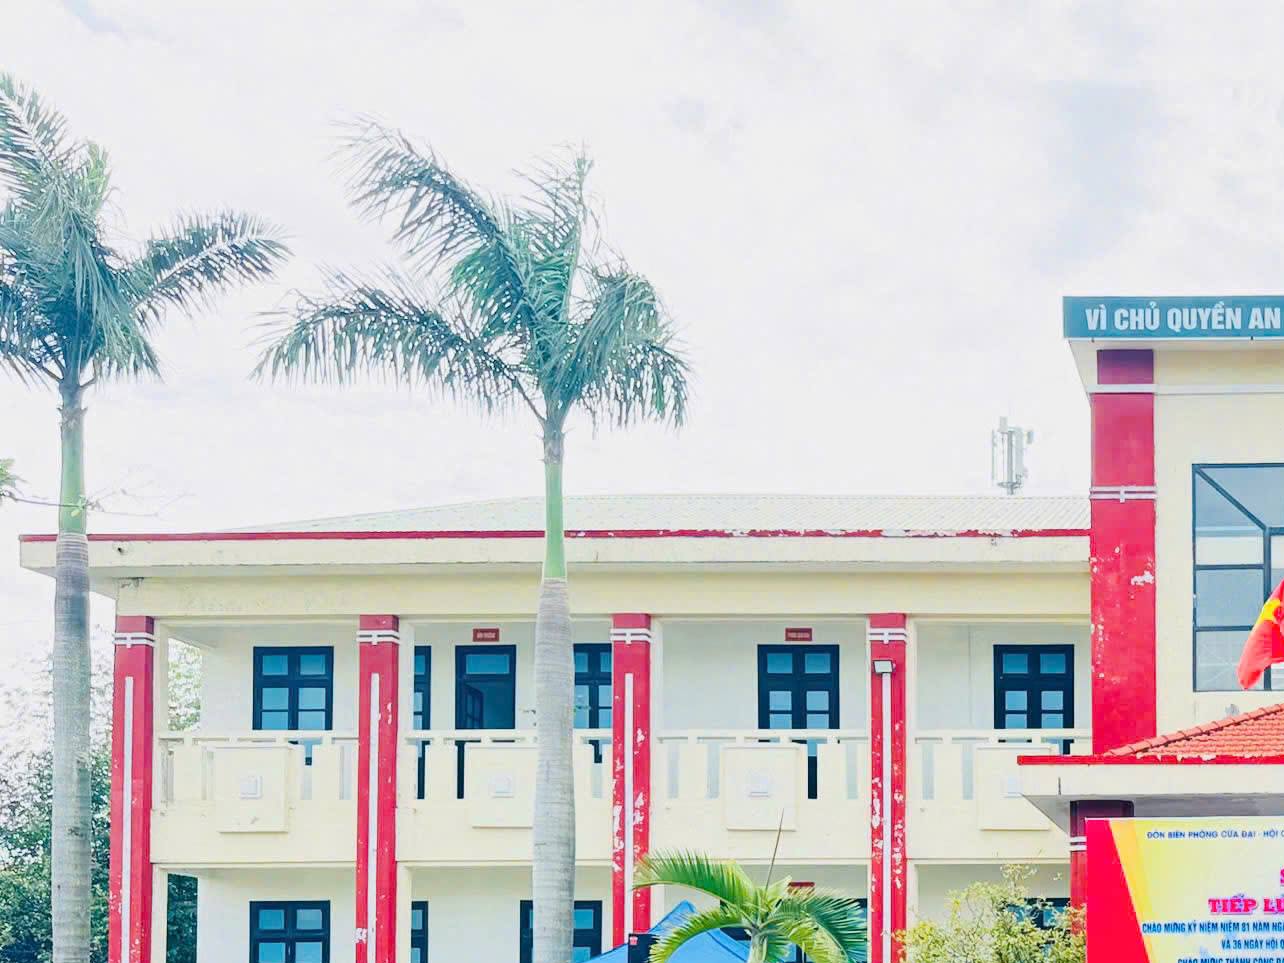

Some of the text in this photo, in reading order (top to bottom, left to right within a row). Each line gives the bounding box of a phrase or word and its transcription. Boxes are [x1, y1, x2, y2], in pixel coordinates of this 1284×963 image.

[1085, 304, 1107, 330] VÌ
[1114, 301, 1160, 330] CHỦ
[1168, 301, 1241, 332] QUYỀN
[1249, 307, 1280, 329] AN
[1208, 893, 1257, 914] TIẾP
[1241, 922, 1249, 932] 81
[1233, 940, 1242, 949] 36
